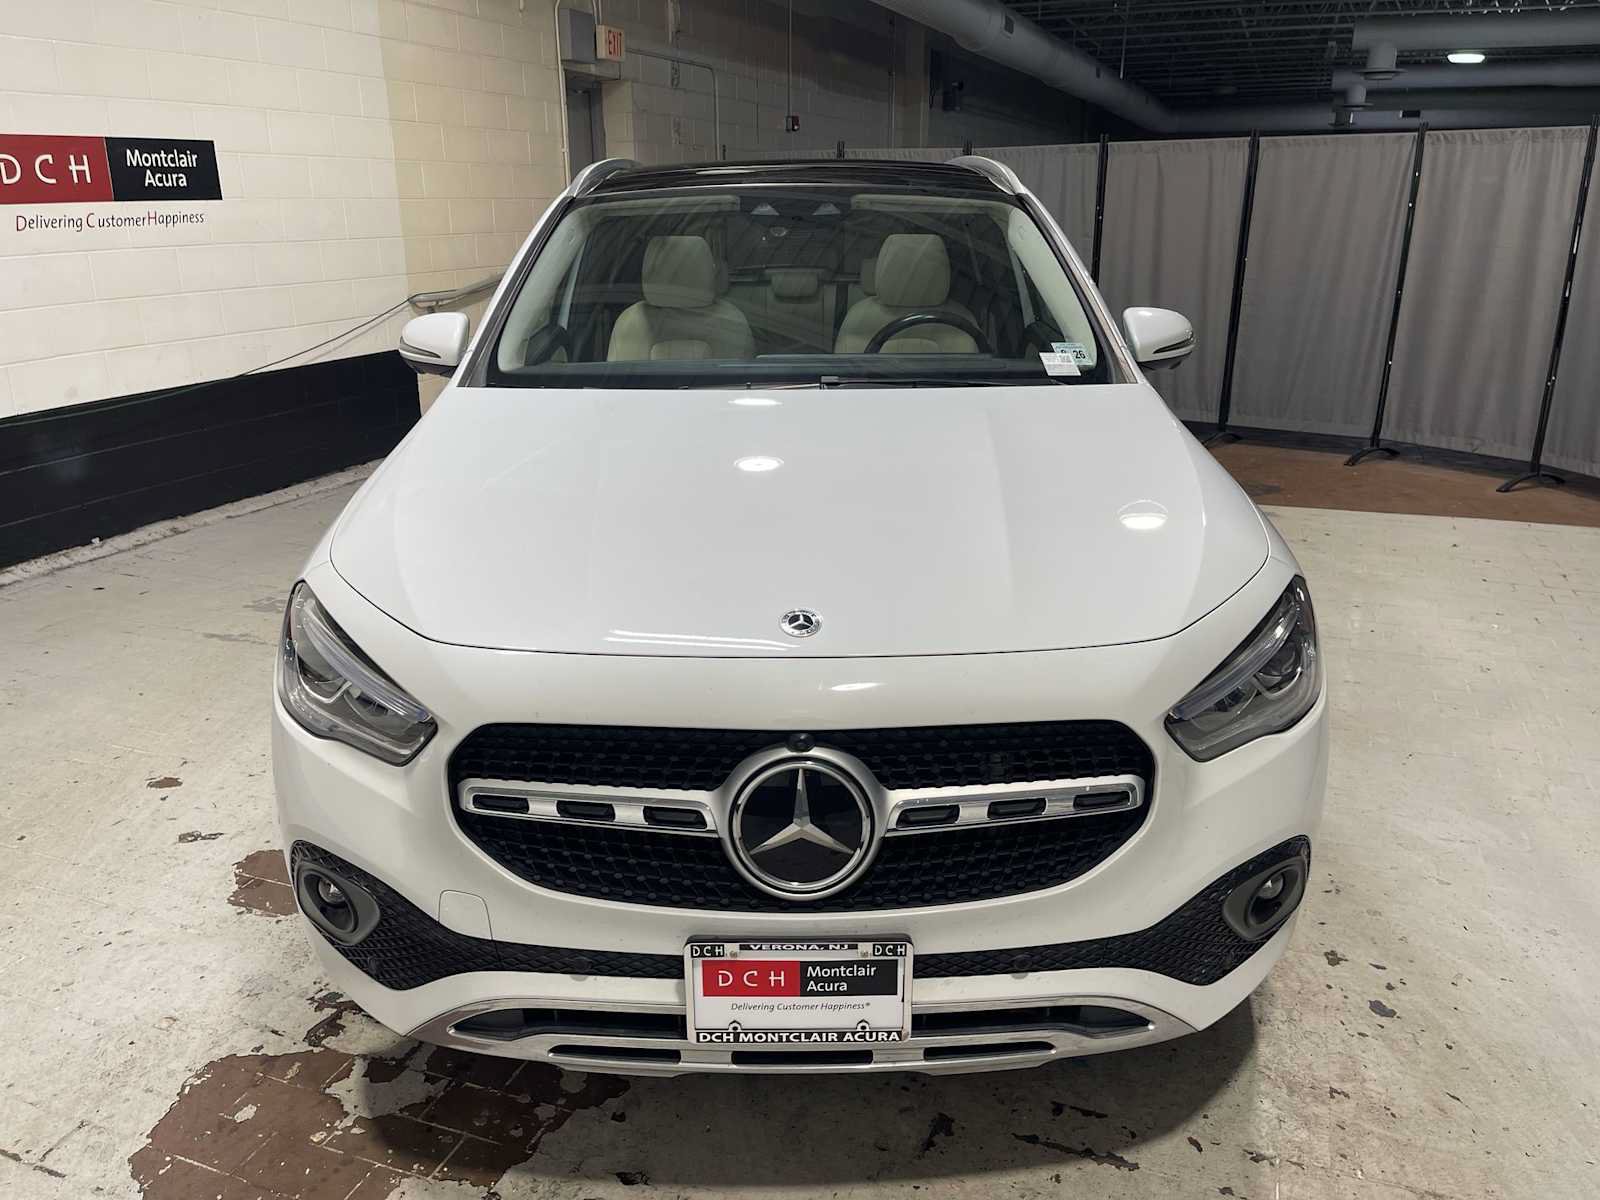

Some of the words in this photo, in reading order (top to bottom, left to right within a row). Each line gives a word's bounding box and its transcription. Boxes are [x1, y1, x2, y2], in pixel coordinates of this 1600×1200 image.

[608, 30, 622, 56] EXIT
[126, 149, 198, 168] Montclair
[144, 170, 188, 187] Acura
[16, 214, 83, 232] Delivering
[147, 210, 205, 228] Happiness
[1072, 350, 1086, 359] 26
[806, 964, 877, 977] Montclair
[806, 980, 848, 992] Acura
[731, 1002, 775, 1012] Delivering
[776, 1002, 818, 1011] Customer
[699, 1032, 734, 1042] DCH
[739, 1032, 838, 1042] MONTCLAIR
[843, 1031, 900, 1042] ACURA
